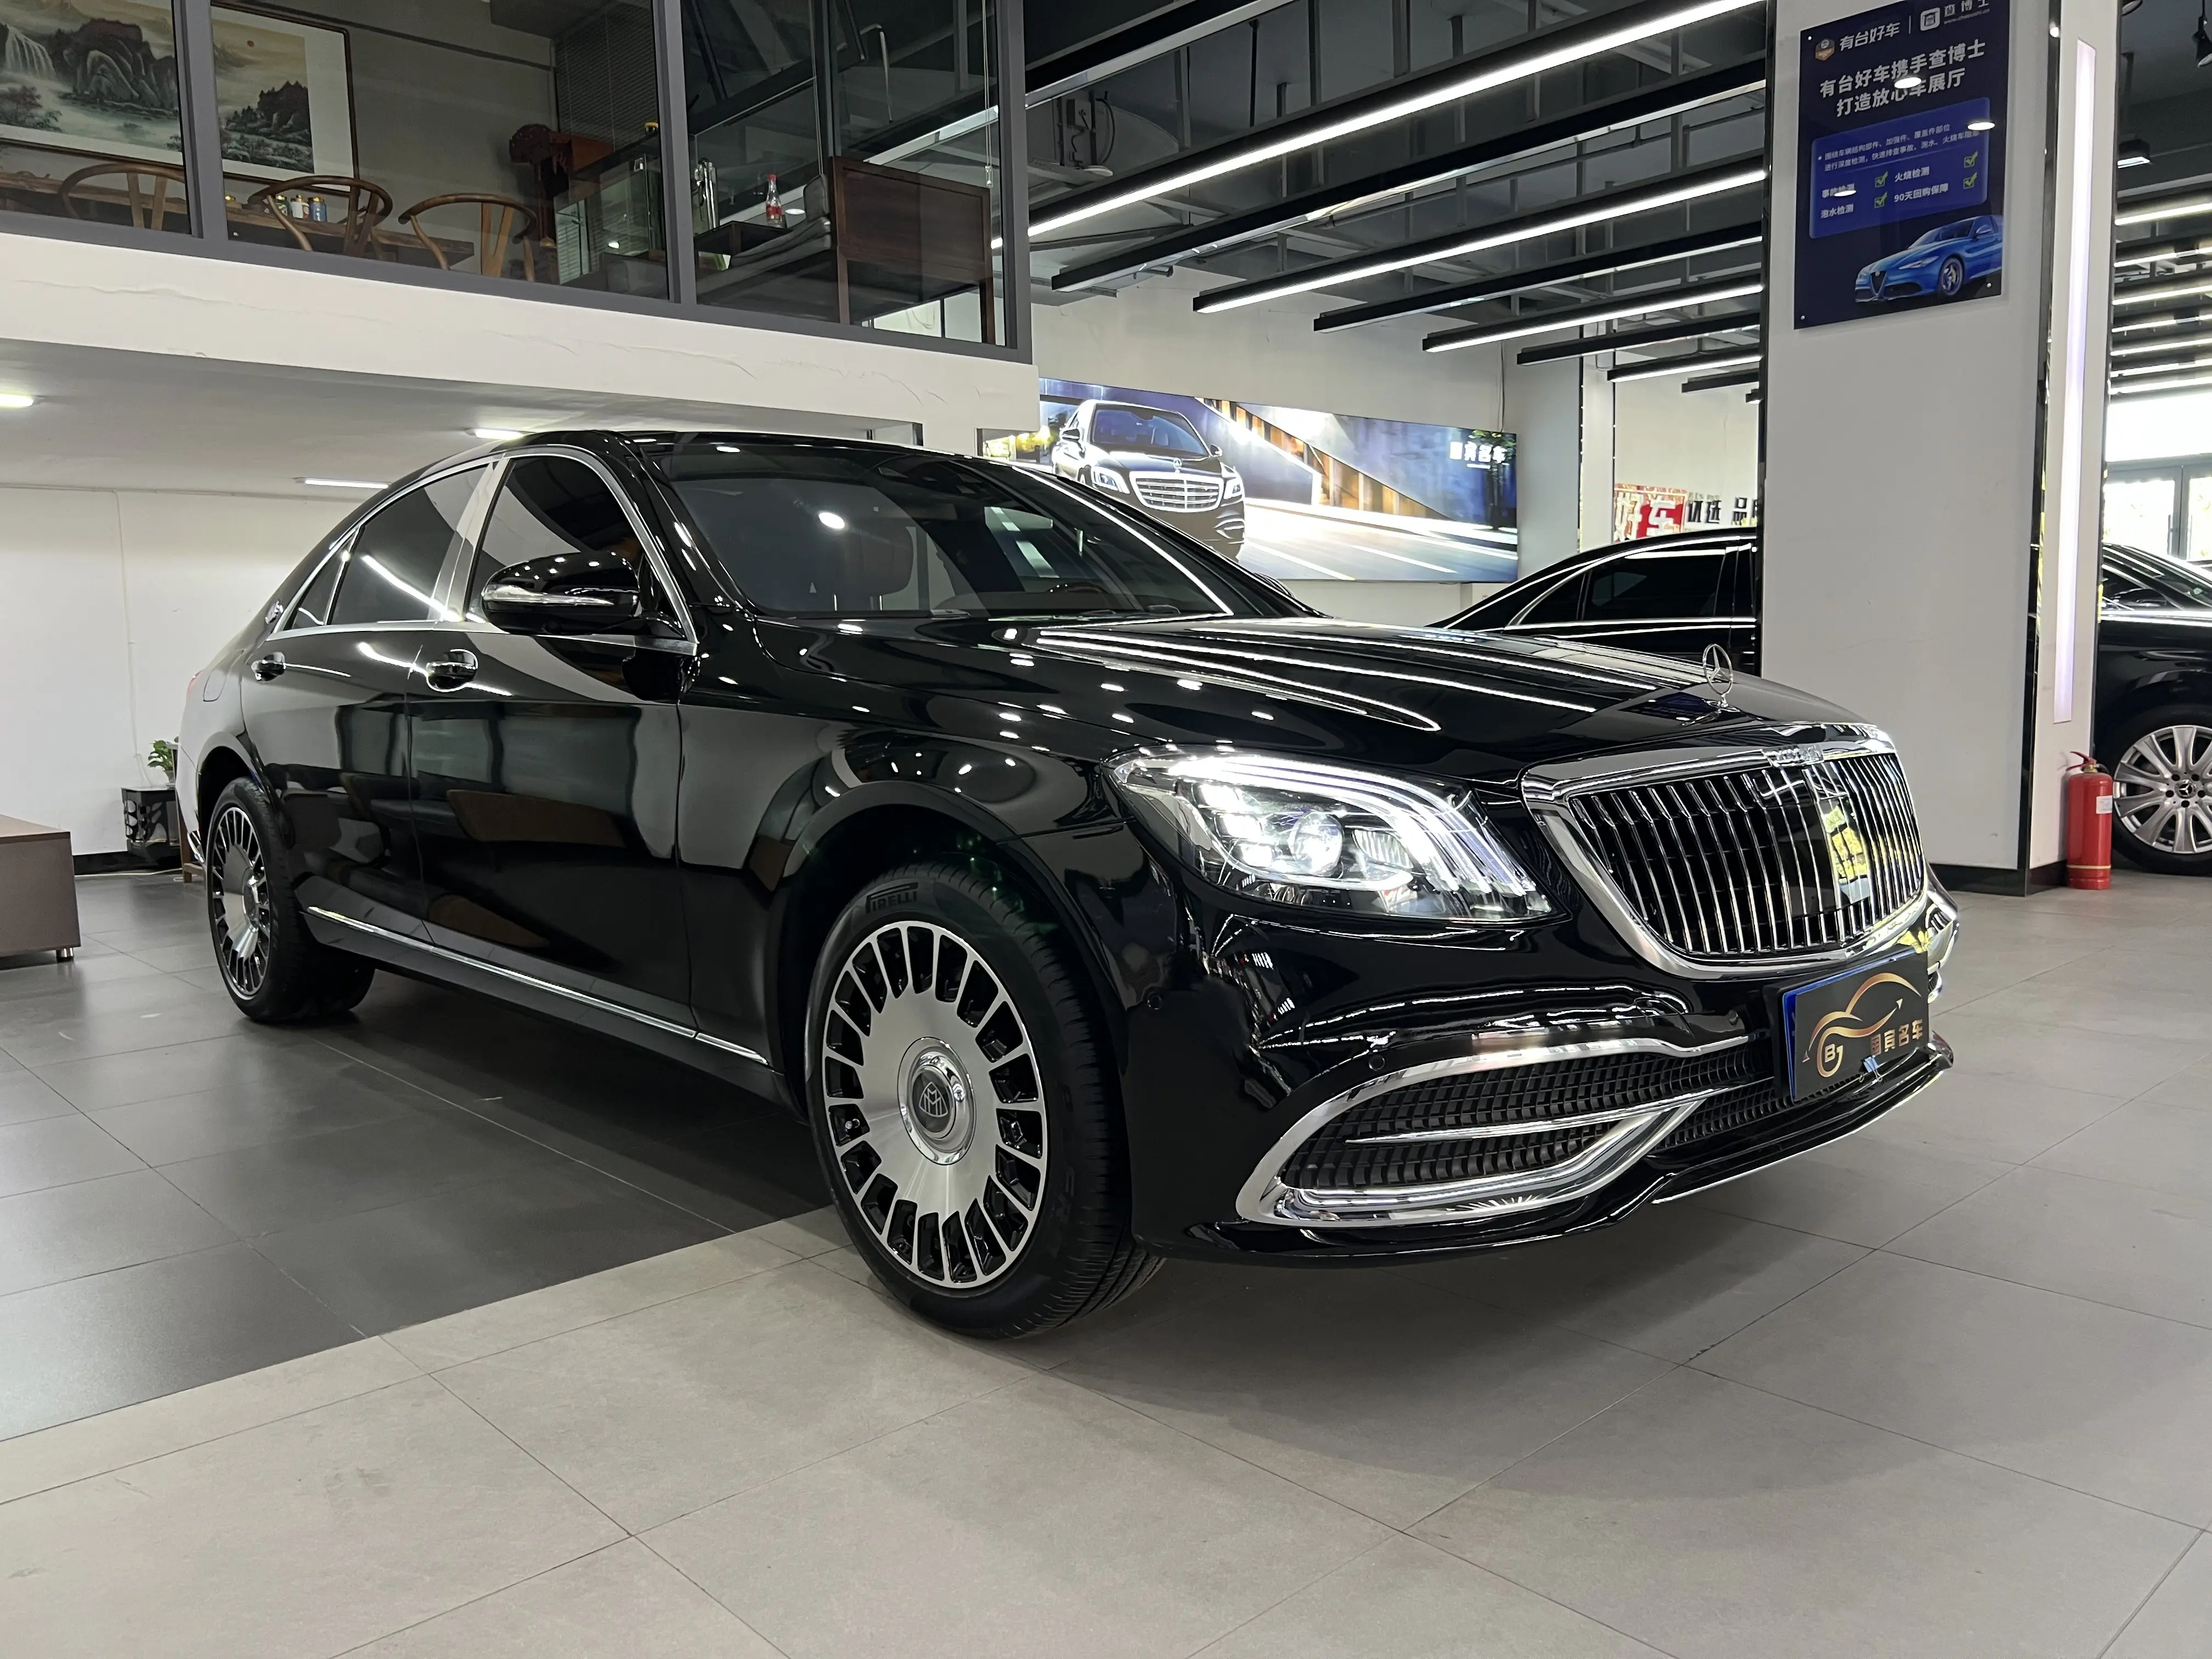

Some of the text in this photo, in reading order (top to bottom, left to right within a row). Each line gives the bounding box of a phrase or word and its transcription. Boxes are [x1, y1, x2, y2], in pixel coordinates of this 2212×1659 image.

[1840, 22, 1900, 51] 有台好车
[1820, 39, 1985, 98] 有台好车携手查博士
[1837, 67, 1965, 117] 打造放心车展厅
[1894, 166, 1929, 182] 火烧检测
[866, 882, 919, 913] PIRELLI
